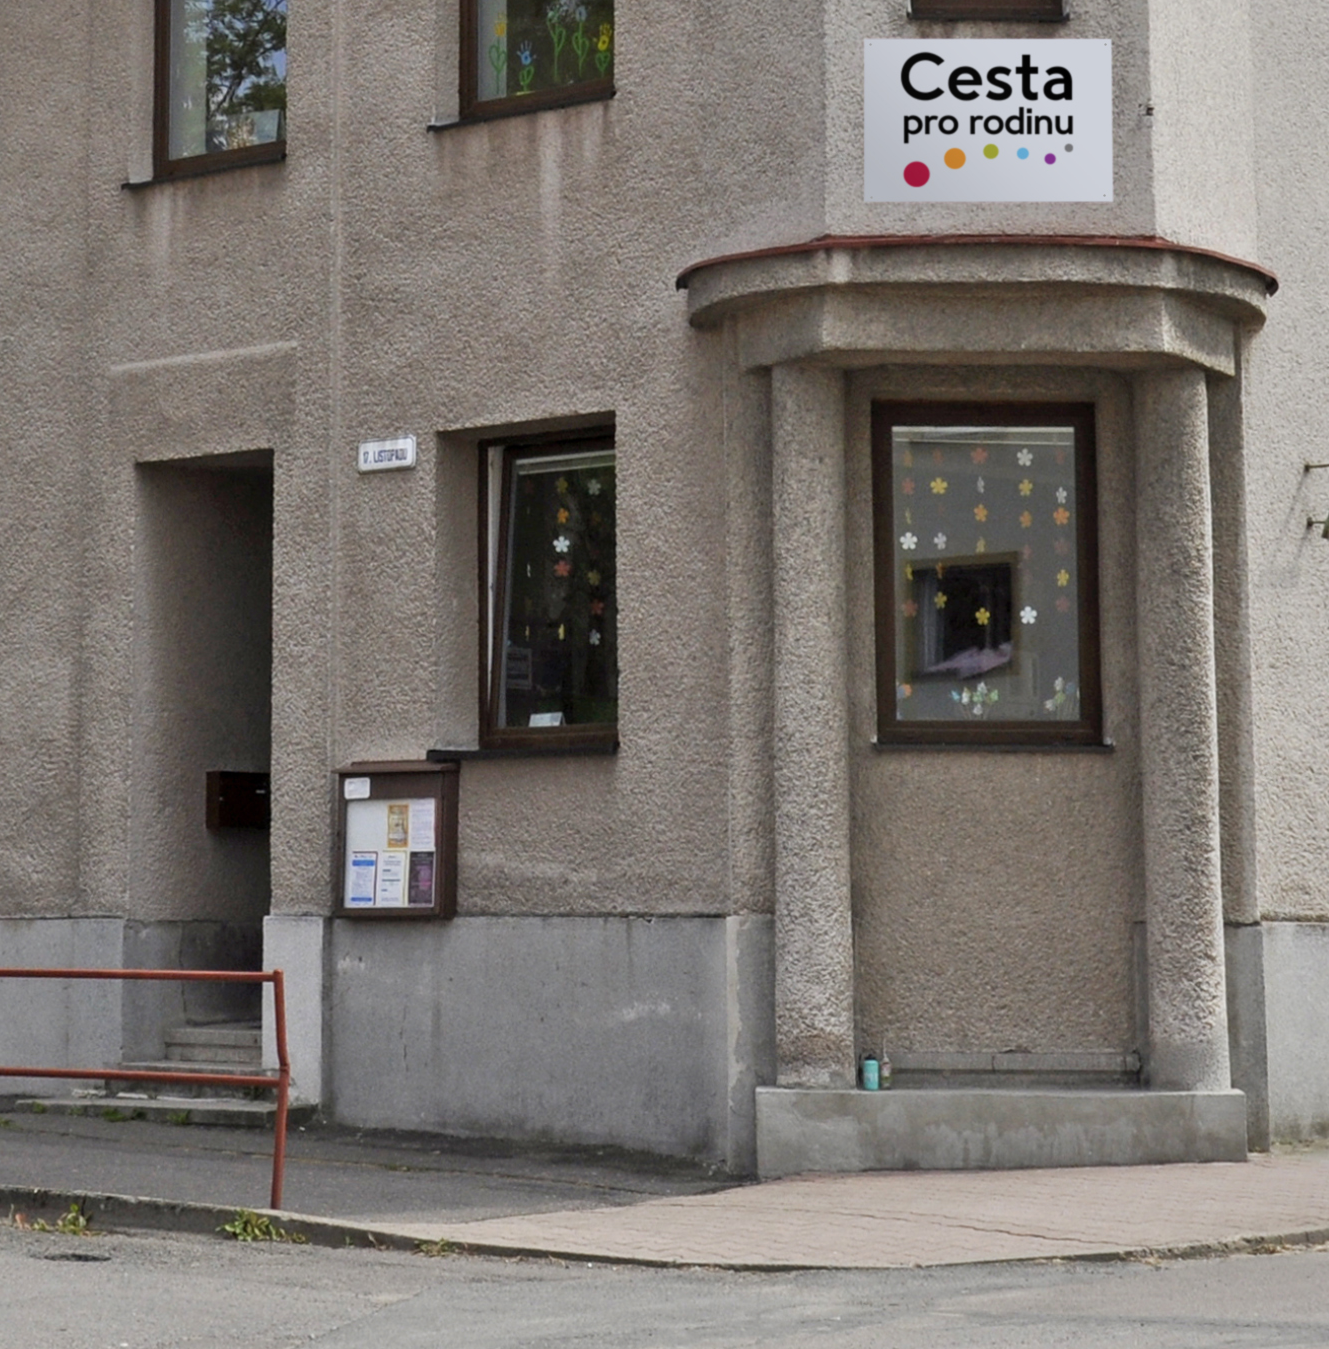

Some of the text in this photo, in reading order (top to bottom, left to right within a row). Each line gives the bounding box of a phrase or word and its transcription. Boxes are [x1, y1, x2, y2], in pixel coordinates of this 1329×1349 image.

[900, 52, 1073, 101] Cesta
[903, 106, 1074, 144] pro rodinu
[373, 448, 407, 463] LISTOPADU
